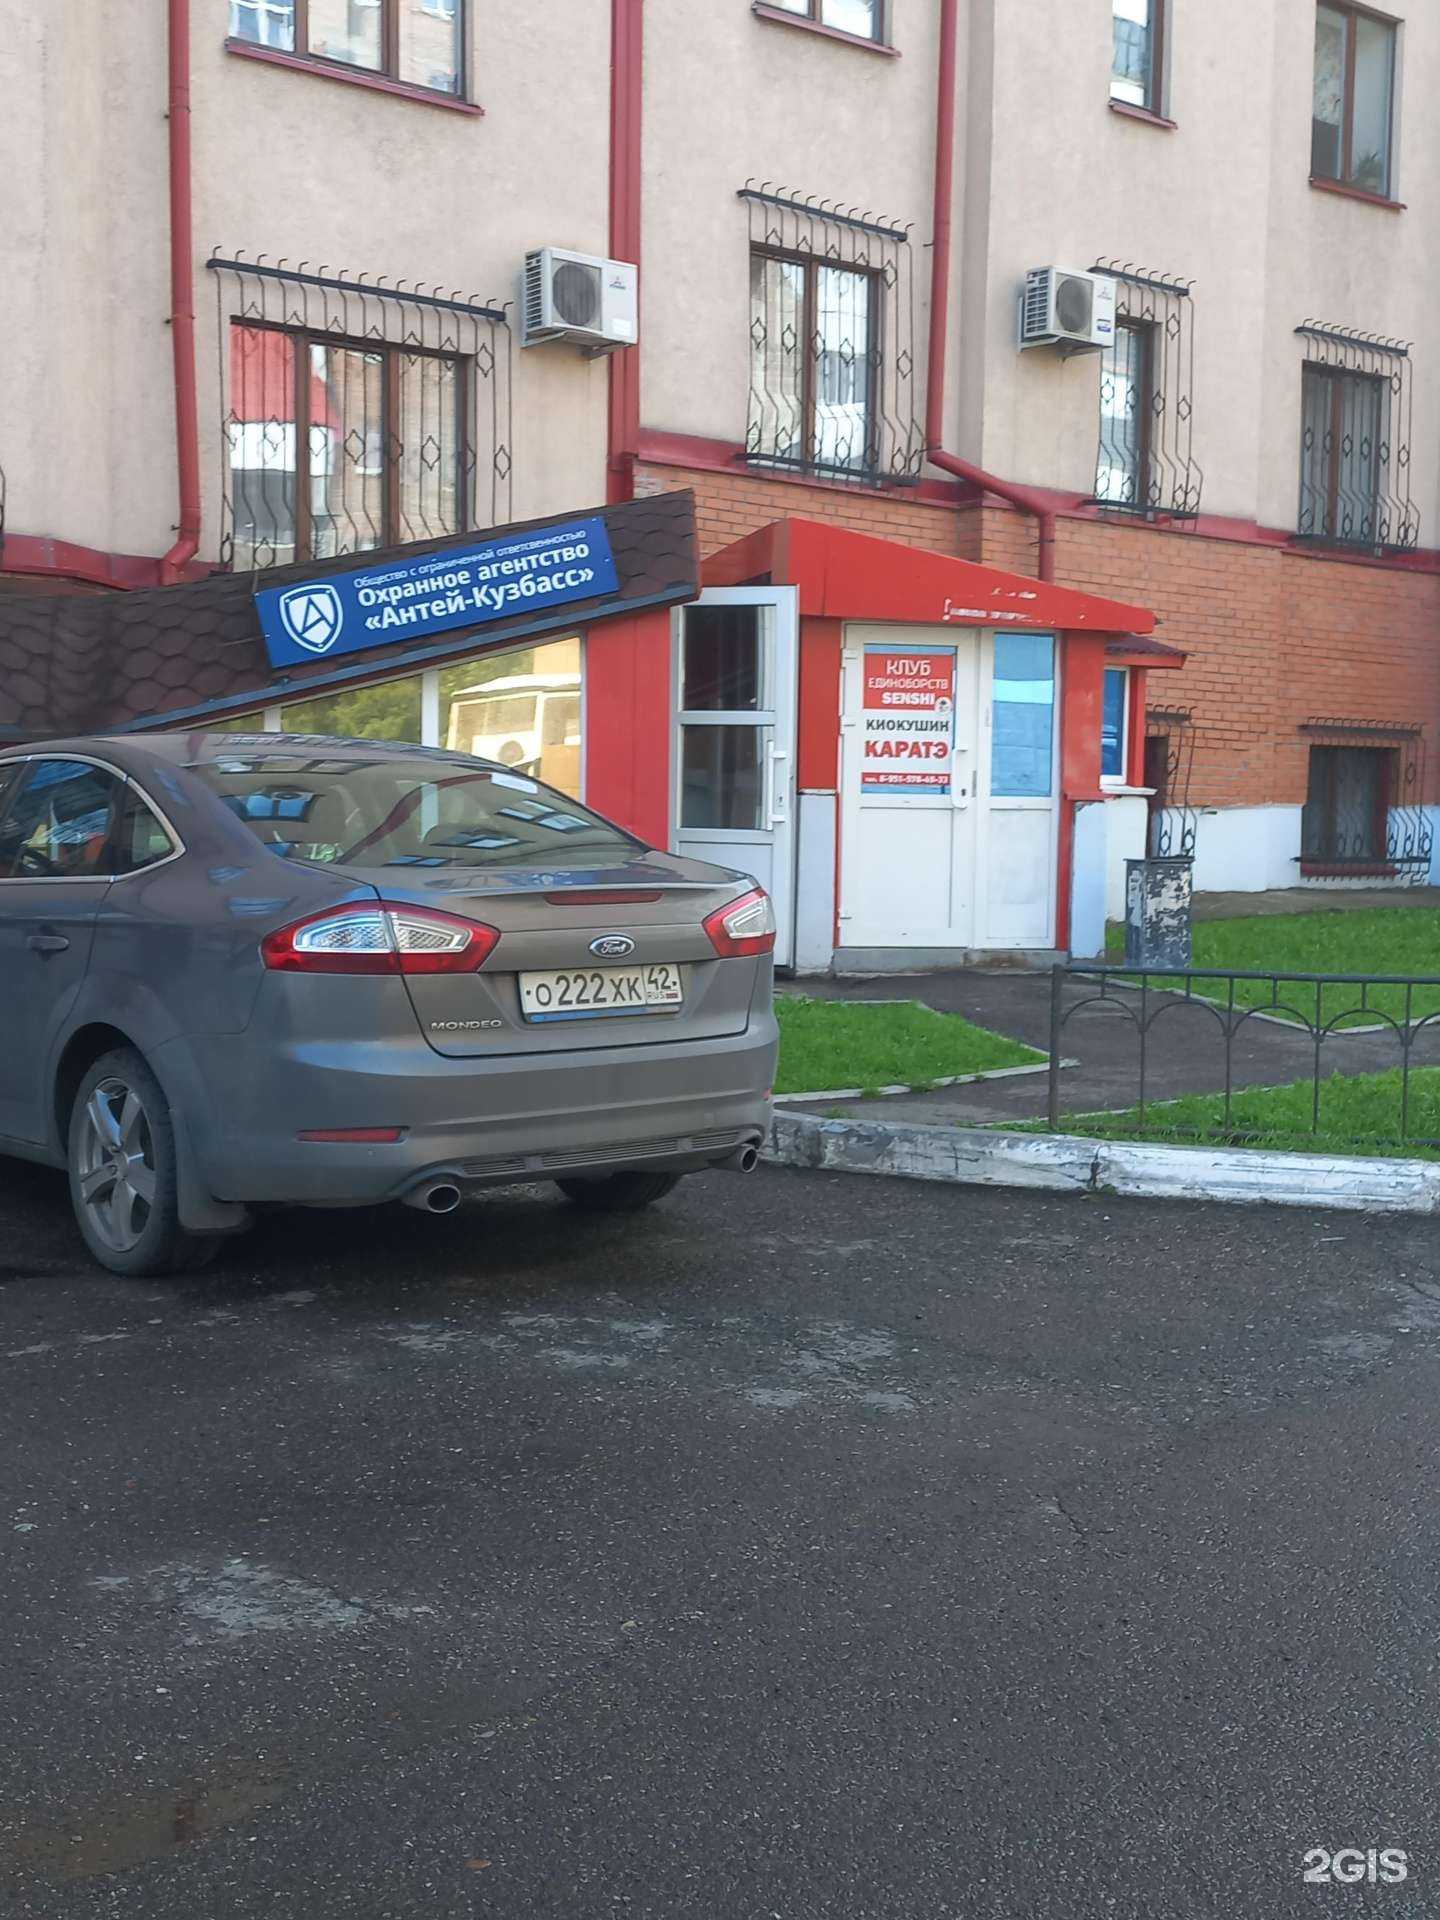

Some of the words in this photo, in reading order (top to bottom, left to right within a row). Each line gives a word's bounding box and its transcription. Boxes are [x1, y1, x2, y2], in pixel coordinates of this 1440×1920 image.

[353, 569, 408, 588] Общество
[358, 570, 471, 608] Охранное
[477, 543, 589, 580] агентство
[364, 568, 594, 630] «Антей-Кузбасс»
[886, 659, 931, 676] КЛУБ
[868, 677, 949, 689] ЕДИНОБОРСТВ
[881, 692, 935, 705] SENSHI
[866, 719, 949, 732] КИОКУШИН
[864, 740, 949, 759] КАРАТЭ
[601, 940, 627, 954] Ford
[431, 1018, 502, 1031] MONDEO
